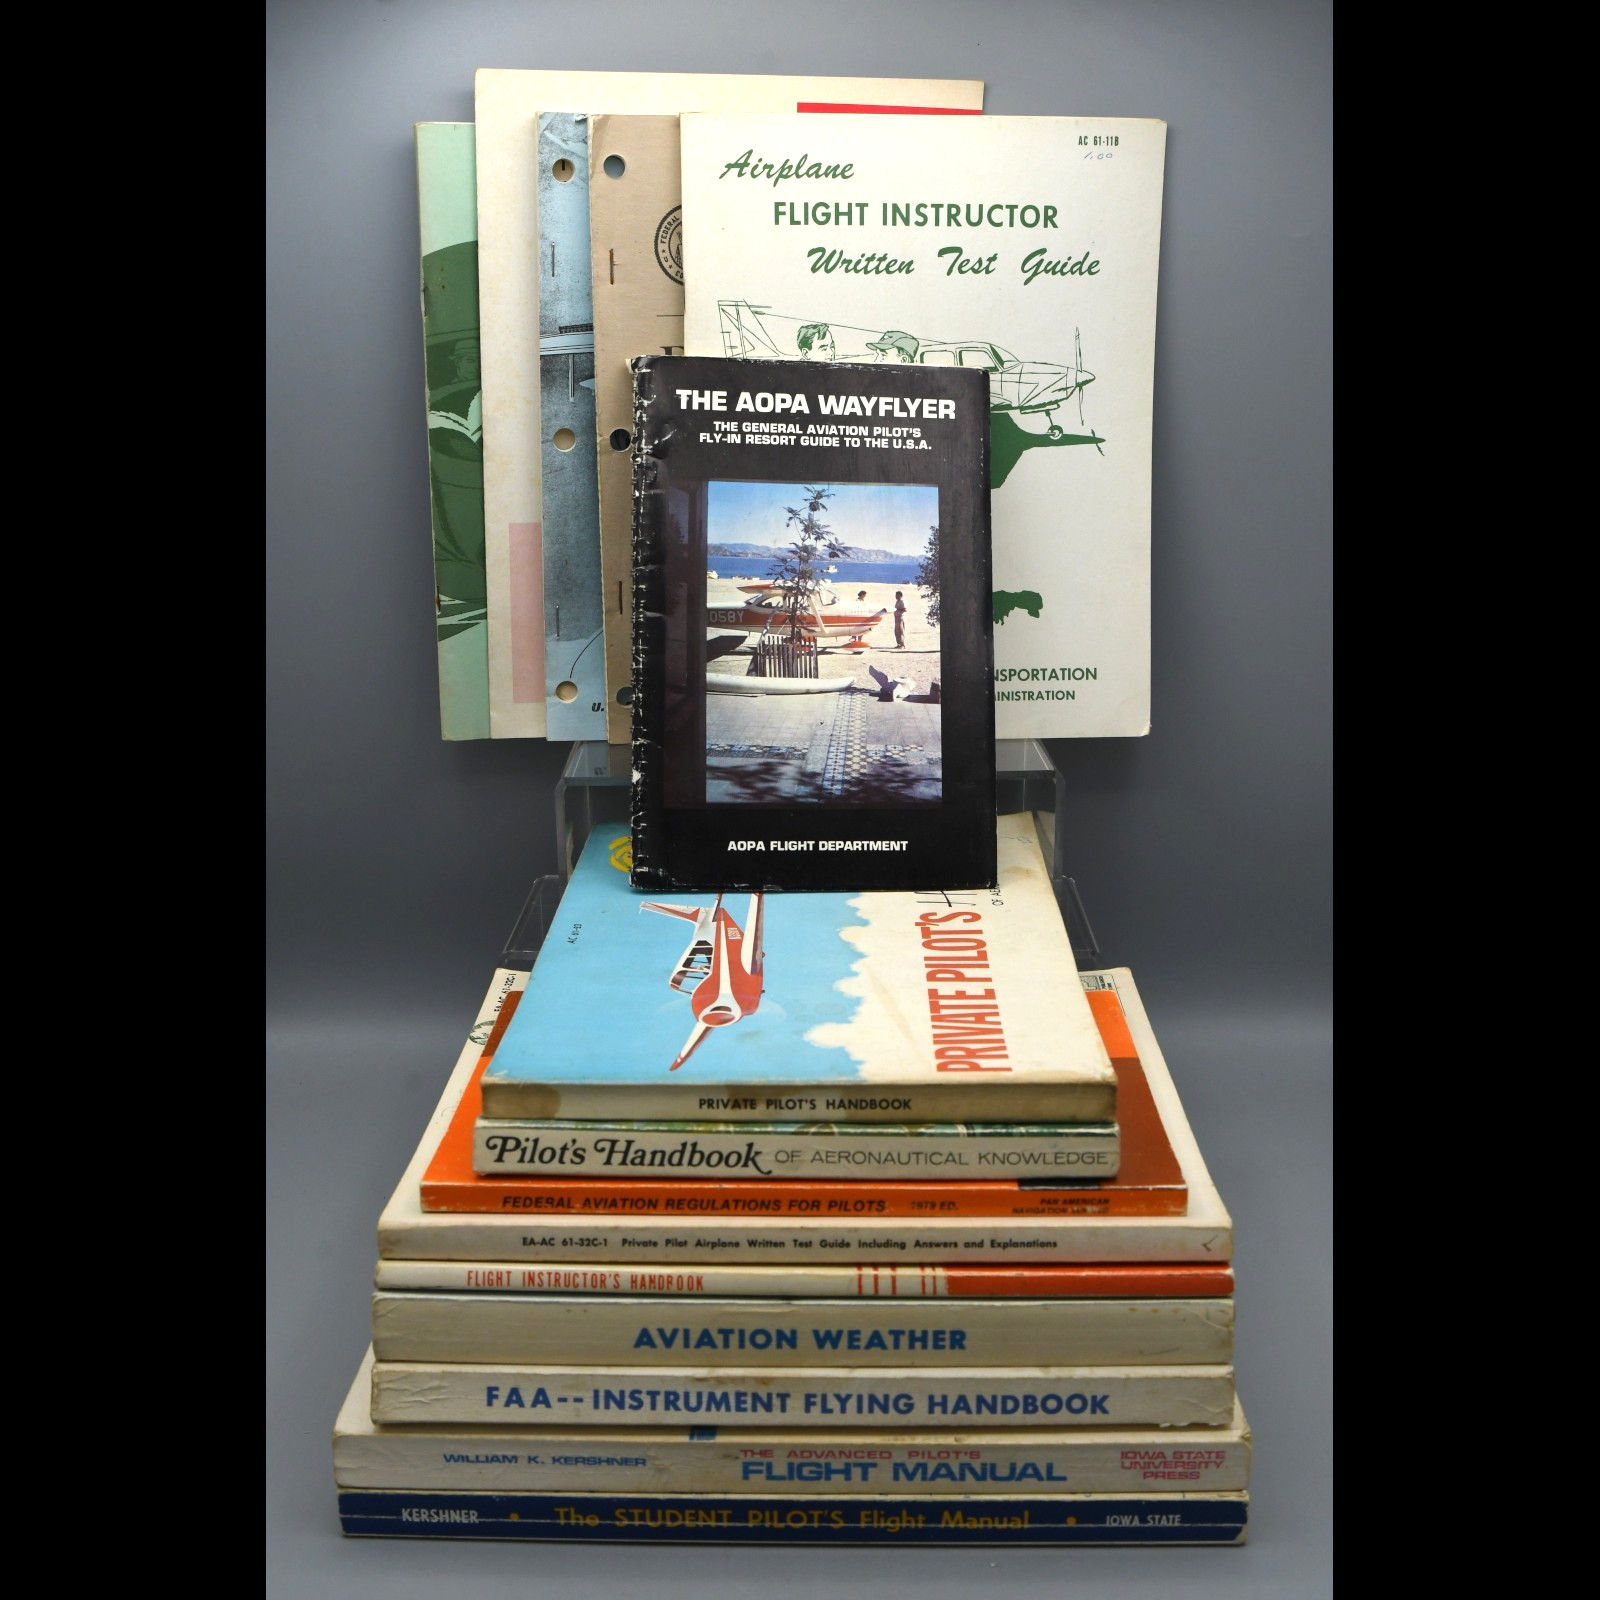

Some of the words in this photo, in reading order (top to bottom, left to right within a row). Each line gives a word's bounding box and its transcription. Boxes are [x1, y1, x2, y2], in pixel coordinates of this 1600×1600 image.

[1077, 135, 1089, 146] AC
[1093, 135, 1119, 146] 61-11B
[719, 149, 855, 188] Airplane
[774, 202, 869, 226] FLIGHT
[882, 203, 1058, 228] INSTRUCTOR
[660, 216, 680, 244] FEDERAL
[807, 246, 915, 275] Written
[937, 246, 998, 276] Test
[1020, 248, 1101, 286] Guide
[675, 389, 728, 411] THE
[735, 391, 810, 414] AOPA
[818, 394, 956, 420] WAYFLYER
[713, 421, 739, 432] THE
[742, 422, 803, 434] GENERAL
[806, 424, 869, 437] AVIATION
[873, 426, 922, 438] PILOT'S
[699, 433, 741, 444] FLY-IN
[745, 434, 796, 447] RESORT
[800, 436, 840, 448] GUIDE
[843, 437, 861, 448] TO
[863, 437, 889, 449] THE
[892, 439, 932, 450] U.S.A.
[995, 690, 1076, 702] INISTRATION
[727, 840, 766, 851] AOPA
[769, 840, 815, 851] FLIGHT
[818, 840, 909, 851] DEPARTMENT
[914, 911, 993, 983] PILOT'S
[927, 988, 1013, 1073] PRIVATE
[698, 1098, 757, 1110] PRIVATE
[766, 1098, 816, 1110] PILOT'S
[826, 1098, 912, 1111] HANDBOOK
[485, 1135, 586, 1165] Pilot's
[593, 1138, 773, 1176] Handbook
[774, 1149, 803, 1164] OF
[810, 1150, 970, 1167] AERONAUTICAL
[977, 1151, 1109, 1166] KNOWLEDGE
[502, 1196, 572, 1209] FEDERAL
[580, 1197, 658, 1210] AVIATION
[664, 1198, 781, 1212] REGULATIONS
[788, 1199, 821, 1212] FOR
[827, 1199, 886, 1212] PILOTS
[522, 1237, 556, 1248] EA-AC
[562, 1238, 608, 1248] 61-32C-1
[622, 1238, 659, 1249] Private
[665, 1238, 688, 1249] Pilot
[695, 1238, 741, 1250] Airplane
[747, 1238, 786, 1249] Written
[793, 1238, 813, 1249] Test
[820, 1239, 851, 1249] Guide
[858, 1239, 906, 1251] Including
[913, 1239, 958, 1250] Answers
[964, 1239, 984, 1250] and
[990, 1239, 1058, 1252] Explanations
[467, 1270, 512, 1288] FLIGHT
[522, 1271, 620, 1290] INSTRUCTOR'S
[633, 1327, 798, 1350] AVIATION
[812, 1328, 967, 1351] WEATHER
[804, 1393, 915, 1415] FLYING
[928, 1393, 1110, 1415] HANDBOOK
[443, 1453, 518, 1465] WILLIAM
[527, 1455, 545, 1466] K.
[552, 1456, 647, 1467] KERSHNER
[740, 1449, 774, 1459] THE
[786, 1450, 893, 1460] ADVANCED
[907, 1450, 982, 1461] PILOT'S
[1121, 1450, 1167, 1460] IOWA
[1172, 1450, 1227, 1460] STATE
[741, 1461, 878, 1482] FLIGHT
[892, 1462, 1068, 1483] MANUAL
[1121, 1460, 1224, 1471] UNIVERSITY
[1142, 1470, 1201, 1480] PRESS
[401, 1507, 479, 1524] KERSHNER
[554, 1507, 600, 1526] The
[613, 1508, 732, 1528] STUDENT
[748, 1510, 845, 1529] PILOT'S
[859, 1510, 926, 1533] Flight
[940, 1510, 1029, 1530] Manual
[1106, 1514, 1141, 1527] IOWA
[1146, 1514, 1182, 1527] STATE
